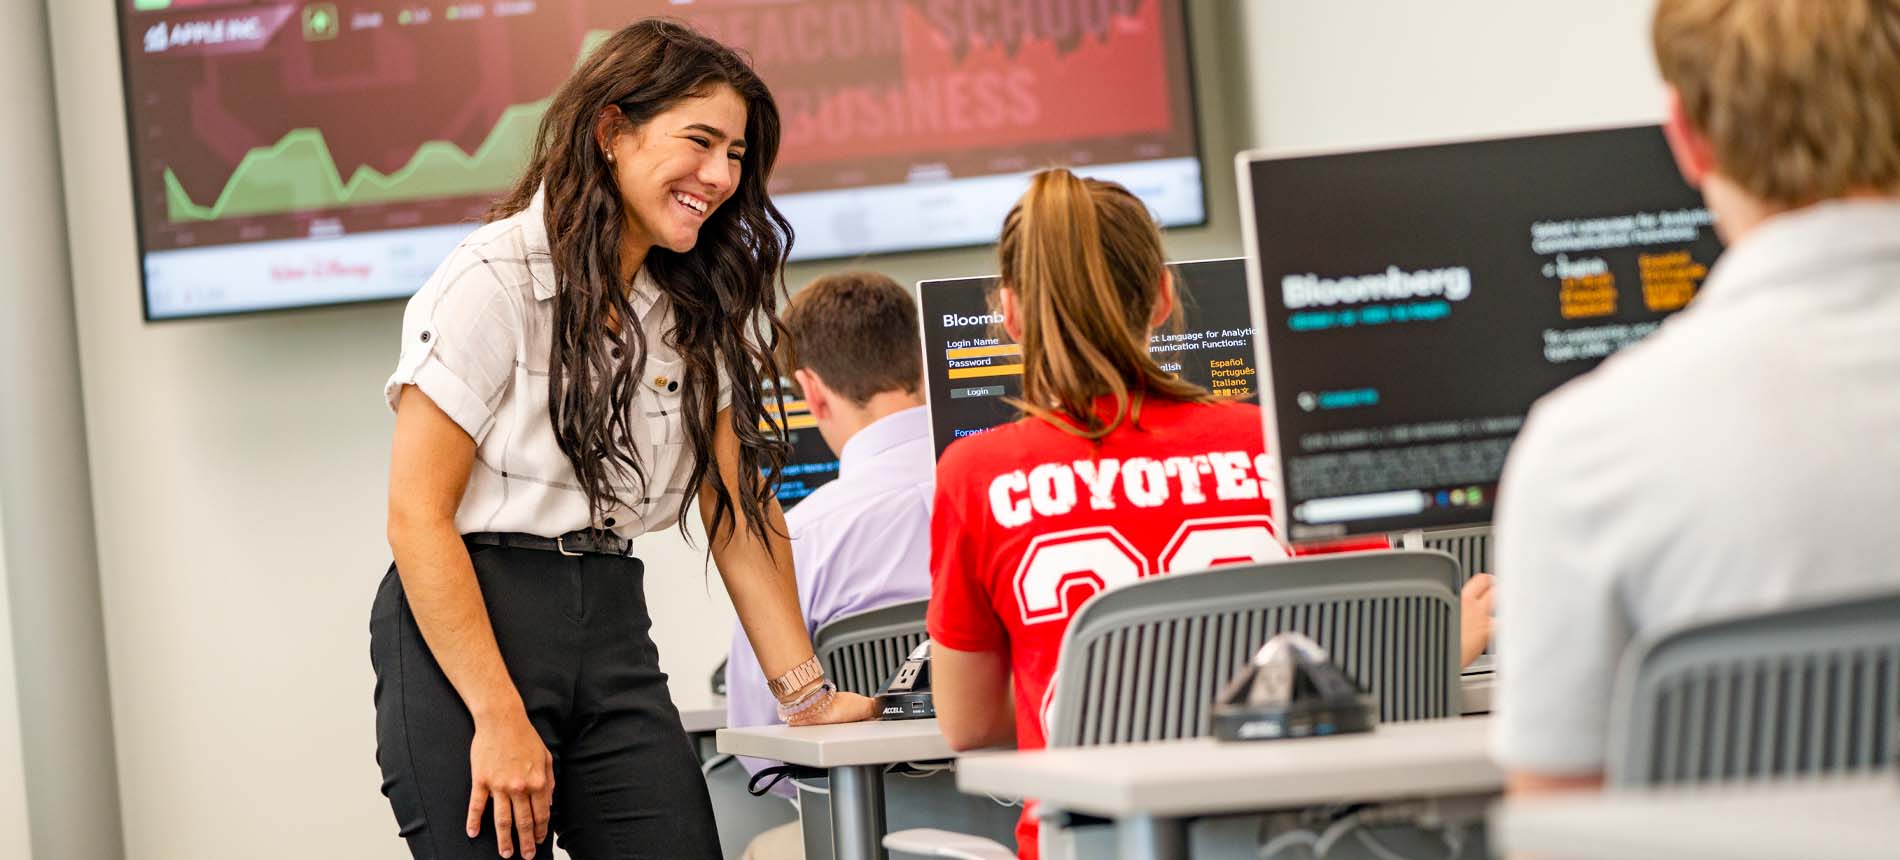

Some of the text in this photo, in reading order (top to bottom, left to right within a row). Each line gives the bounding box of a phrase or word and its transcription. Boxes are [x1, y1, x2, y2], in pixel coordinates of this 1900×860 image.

[170, 19, 224, 46] APPLE
[1281, 266, 1471, 308] Bloomberg
[1162, 332, 1203, 342] Language
[1206, 330, 1219, 338] for
[947, 337, 999, 348] Login Name
[1202, 338, 1247, 348] Functions:
[948, 358, 992, 368] Password
[1210, 358, 1244, 368] Español
[1212, 367, 1256, 377] Português
[1212, 378, 1247, 388] Italiano
[967, 387, 989, 396] Login
[883, 706, 905, 715] ACCELL
